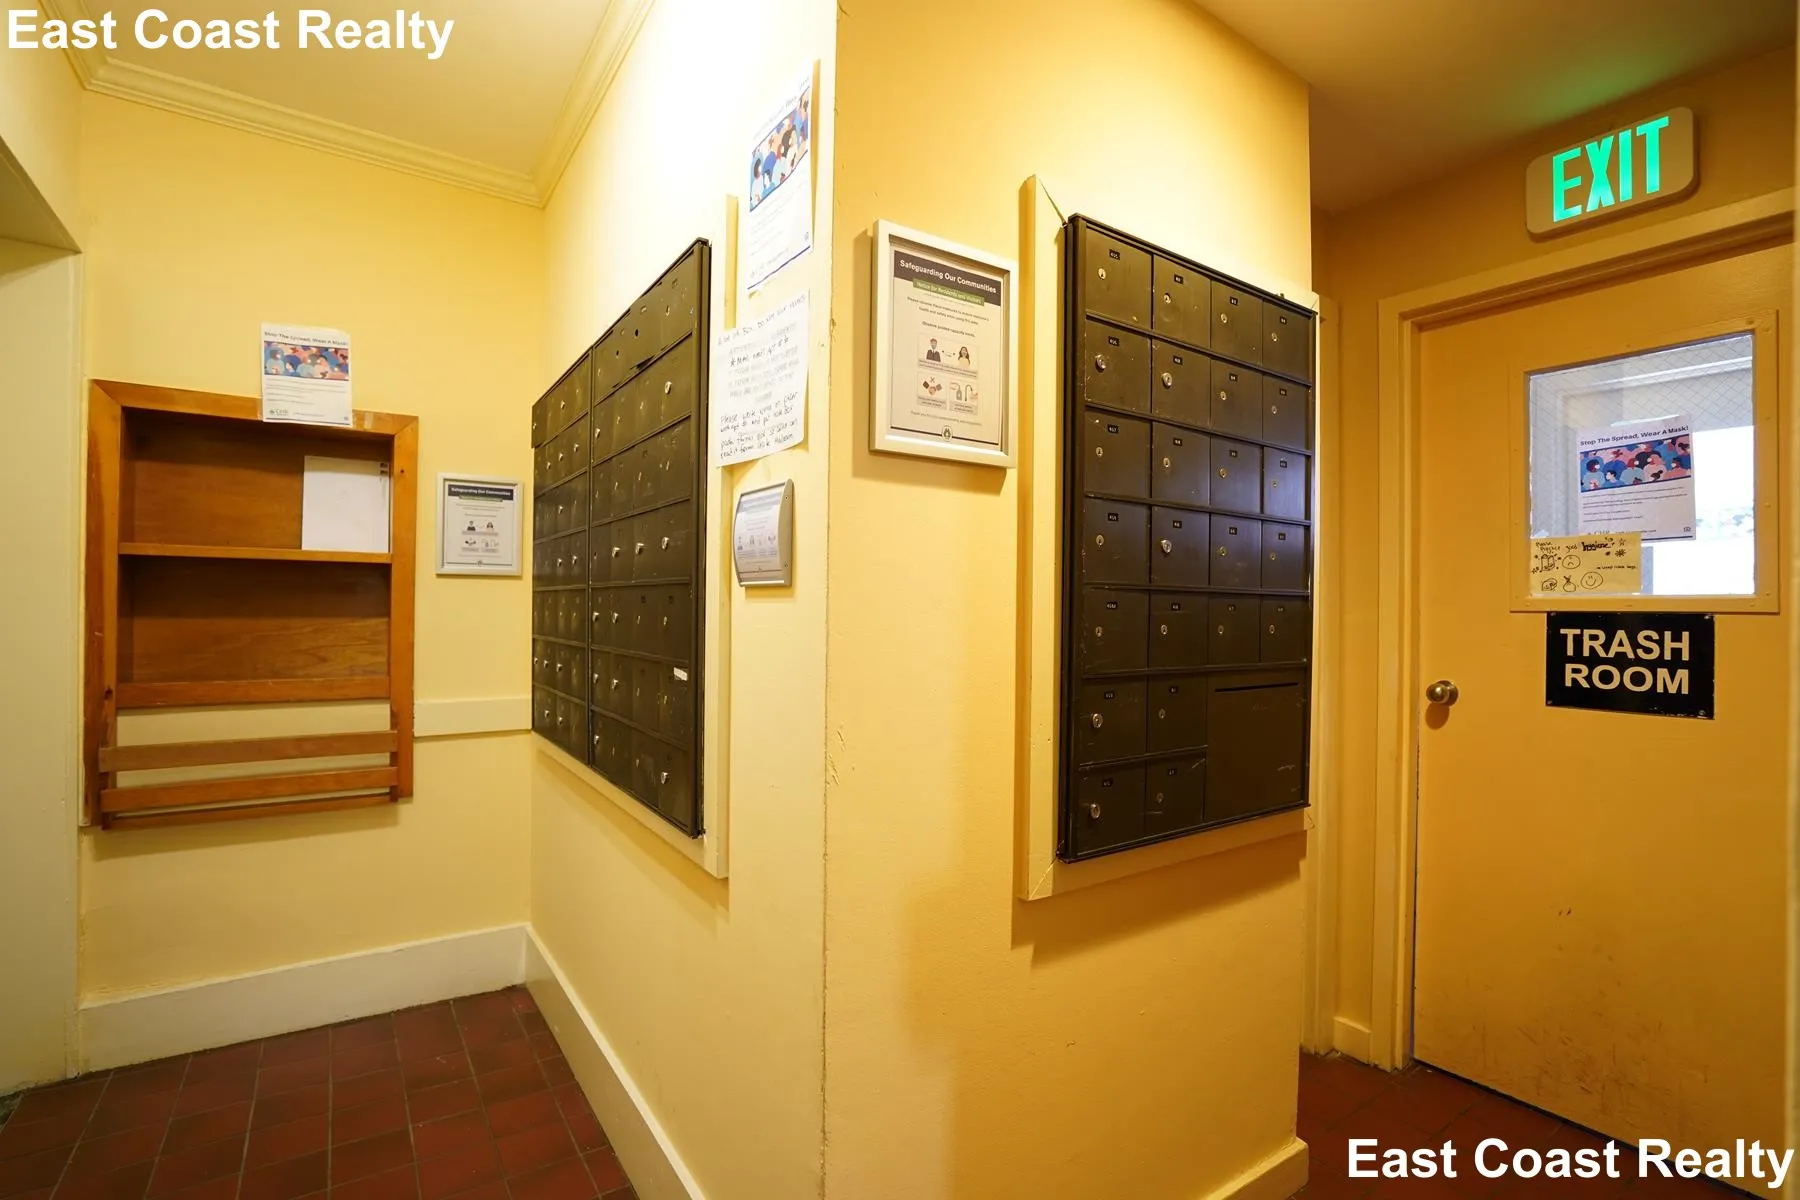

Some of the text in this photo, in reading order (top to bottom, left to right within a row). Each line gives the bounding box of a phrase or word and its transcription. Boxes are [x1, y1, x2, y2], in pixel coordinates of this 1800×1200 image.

[1552, 115, 1670, 223] EXIT
[899, 259, 997, 294] Safeguarding Our Communities
[1611, 433, 1639, 442] Spread,
[1640, 430, 1661, 438] Wear
[1668, 425, 1689, 434] Mask!
[1559, 628, 1690, 661] TRASH
[1564, 664, 1689, 695] ROOM
